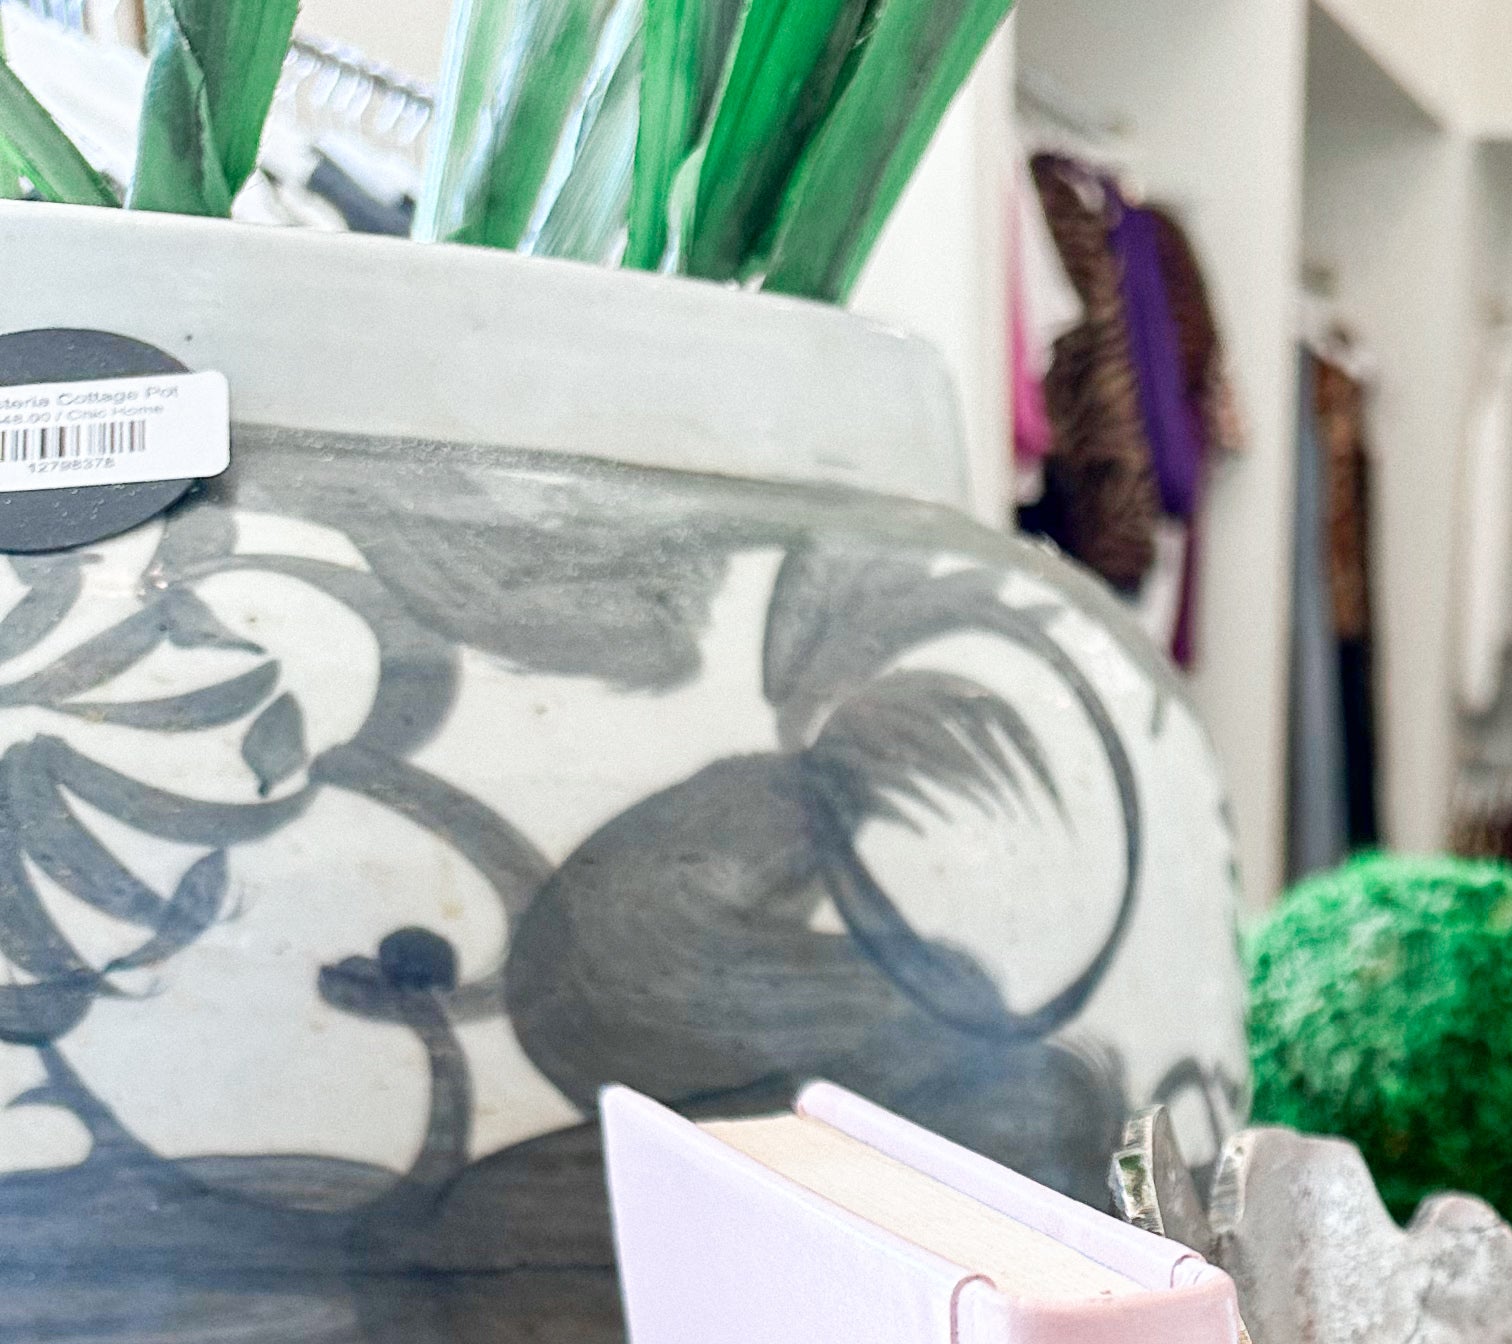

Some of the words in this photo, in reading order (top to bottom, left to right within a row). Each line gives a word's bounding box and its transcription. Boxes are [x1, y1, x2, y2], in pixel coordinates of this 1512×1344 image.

[56, 389, 139, 406] Cottage
[145, 384, 179, 400] Pot
[66, 408, 107, 421] Chic
[112, 404, 165, 417] Home
